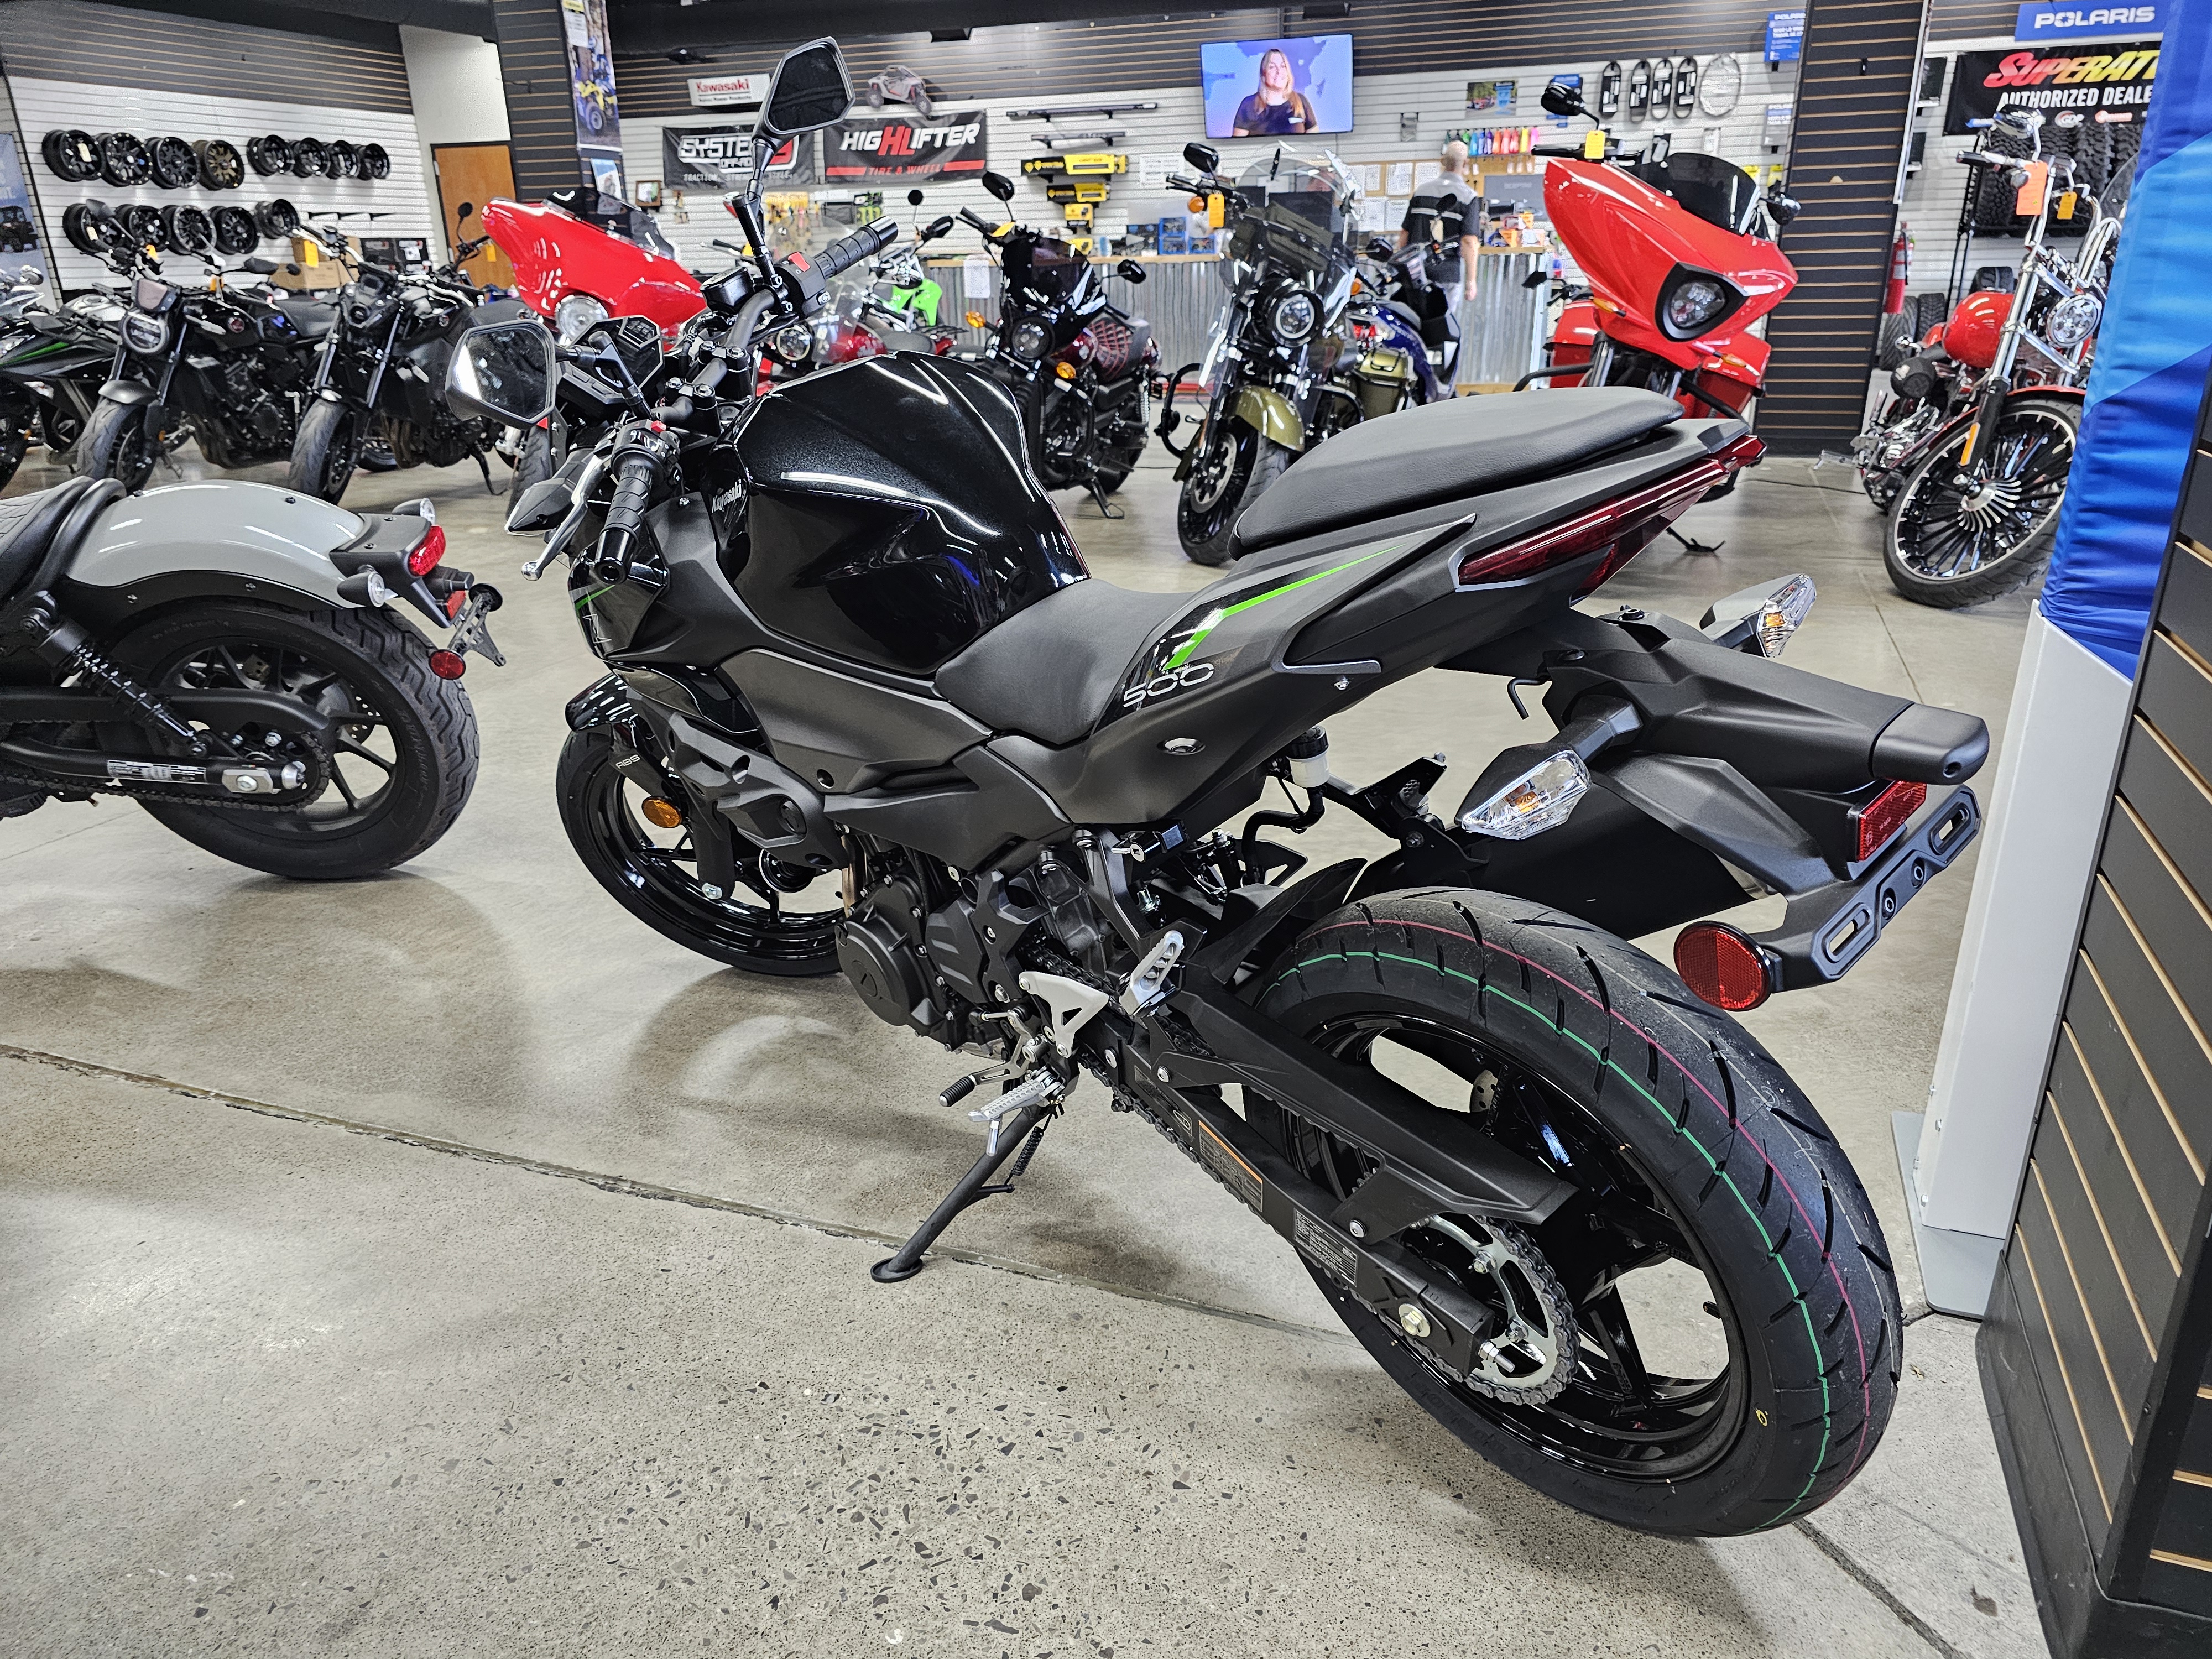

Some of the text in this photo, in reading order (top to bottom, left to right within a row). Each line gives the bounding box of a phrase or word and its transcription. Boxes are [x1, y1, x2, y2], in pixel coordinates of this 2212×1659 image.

[2034, 6, 2156, 29] POLARIS
[696, 79, 750, 92] Kawasaki
[1996, 85, 2154, 112] AUTHORIZED DEALE
[680, 137, 753, 159] SYSTE
[839, 123, 980, 155] HIGHLIFTER
[868, 164, 941, 176] TIRE & WHEEL
[711, 478, 742, 514] Kawasaki
[1123, 662, 1214, 708] 500
